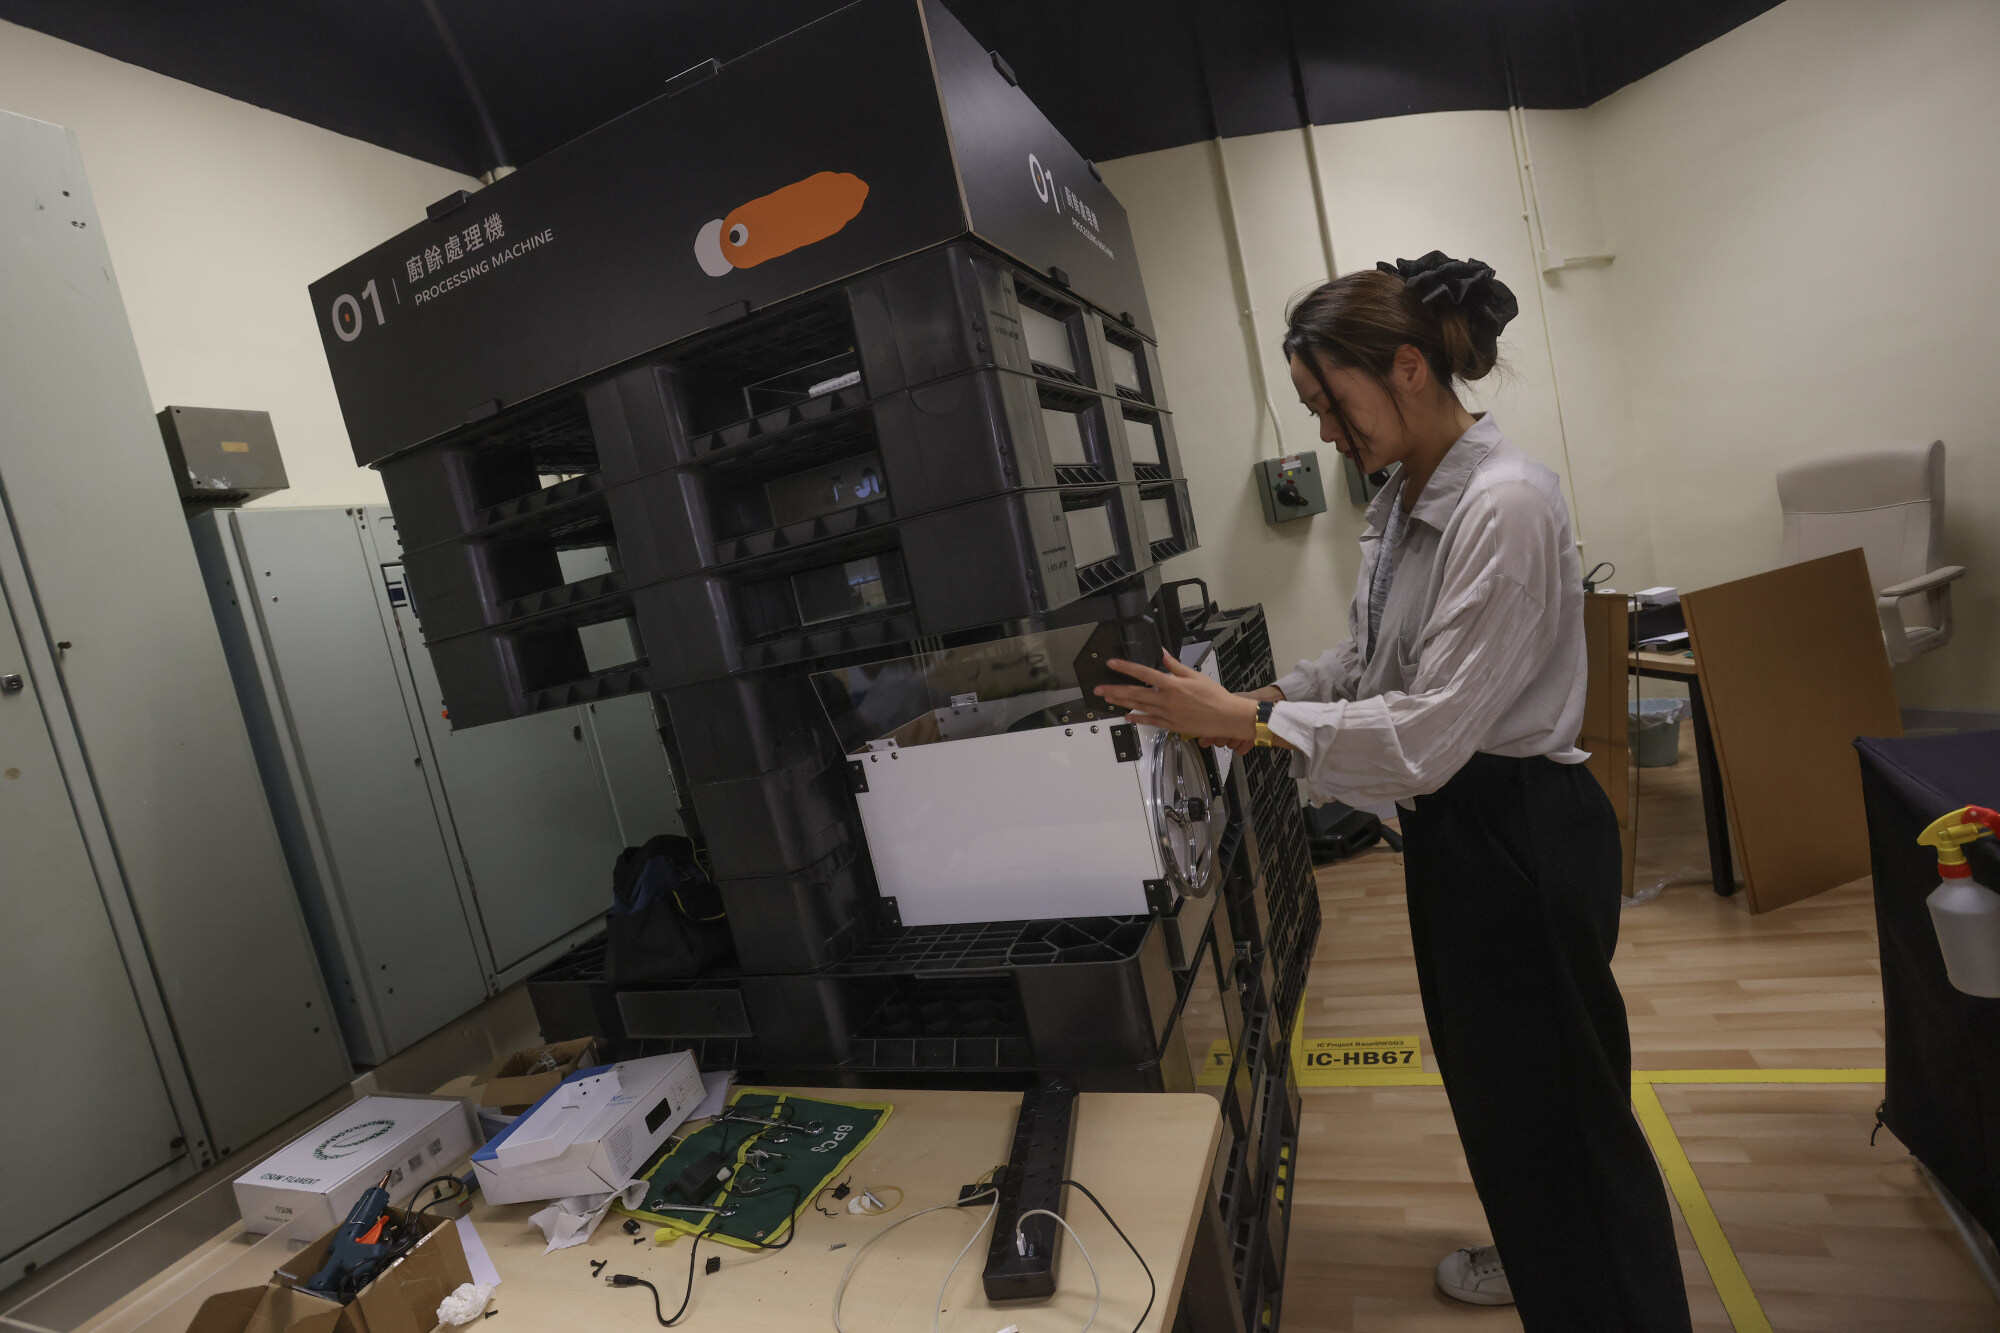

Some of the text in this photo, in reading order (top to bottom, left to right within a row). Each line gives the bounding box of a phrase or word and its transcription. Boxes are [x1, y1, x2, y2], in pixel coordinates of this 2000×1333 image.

[1028, 153, 1060, 214] 01
[405, 212, 506, 284] 廚餘處理機
[414, 228, 555, 306] PROCESSING MACHINE
[331, 278, 386, 342] 01
[1306, 1050, 1415, 1067] IC-HB67
